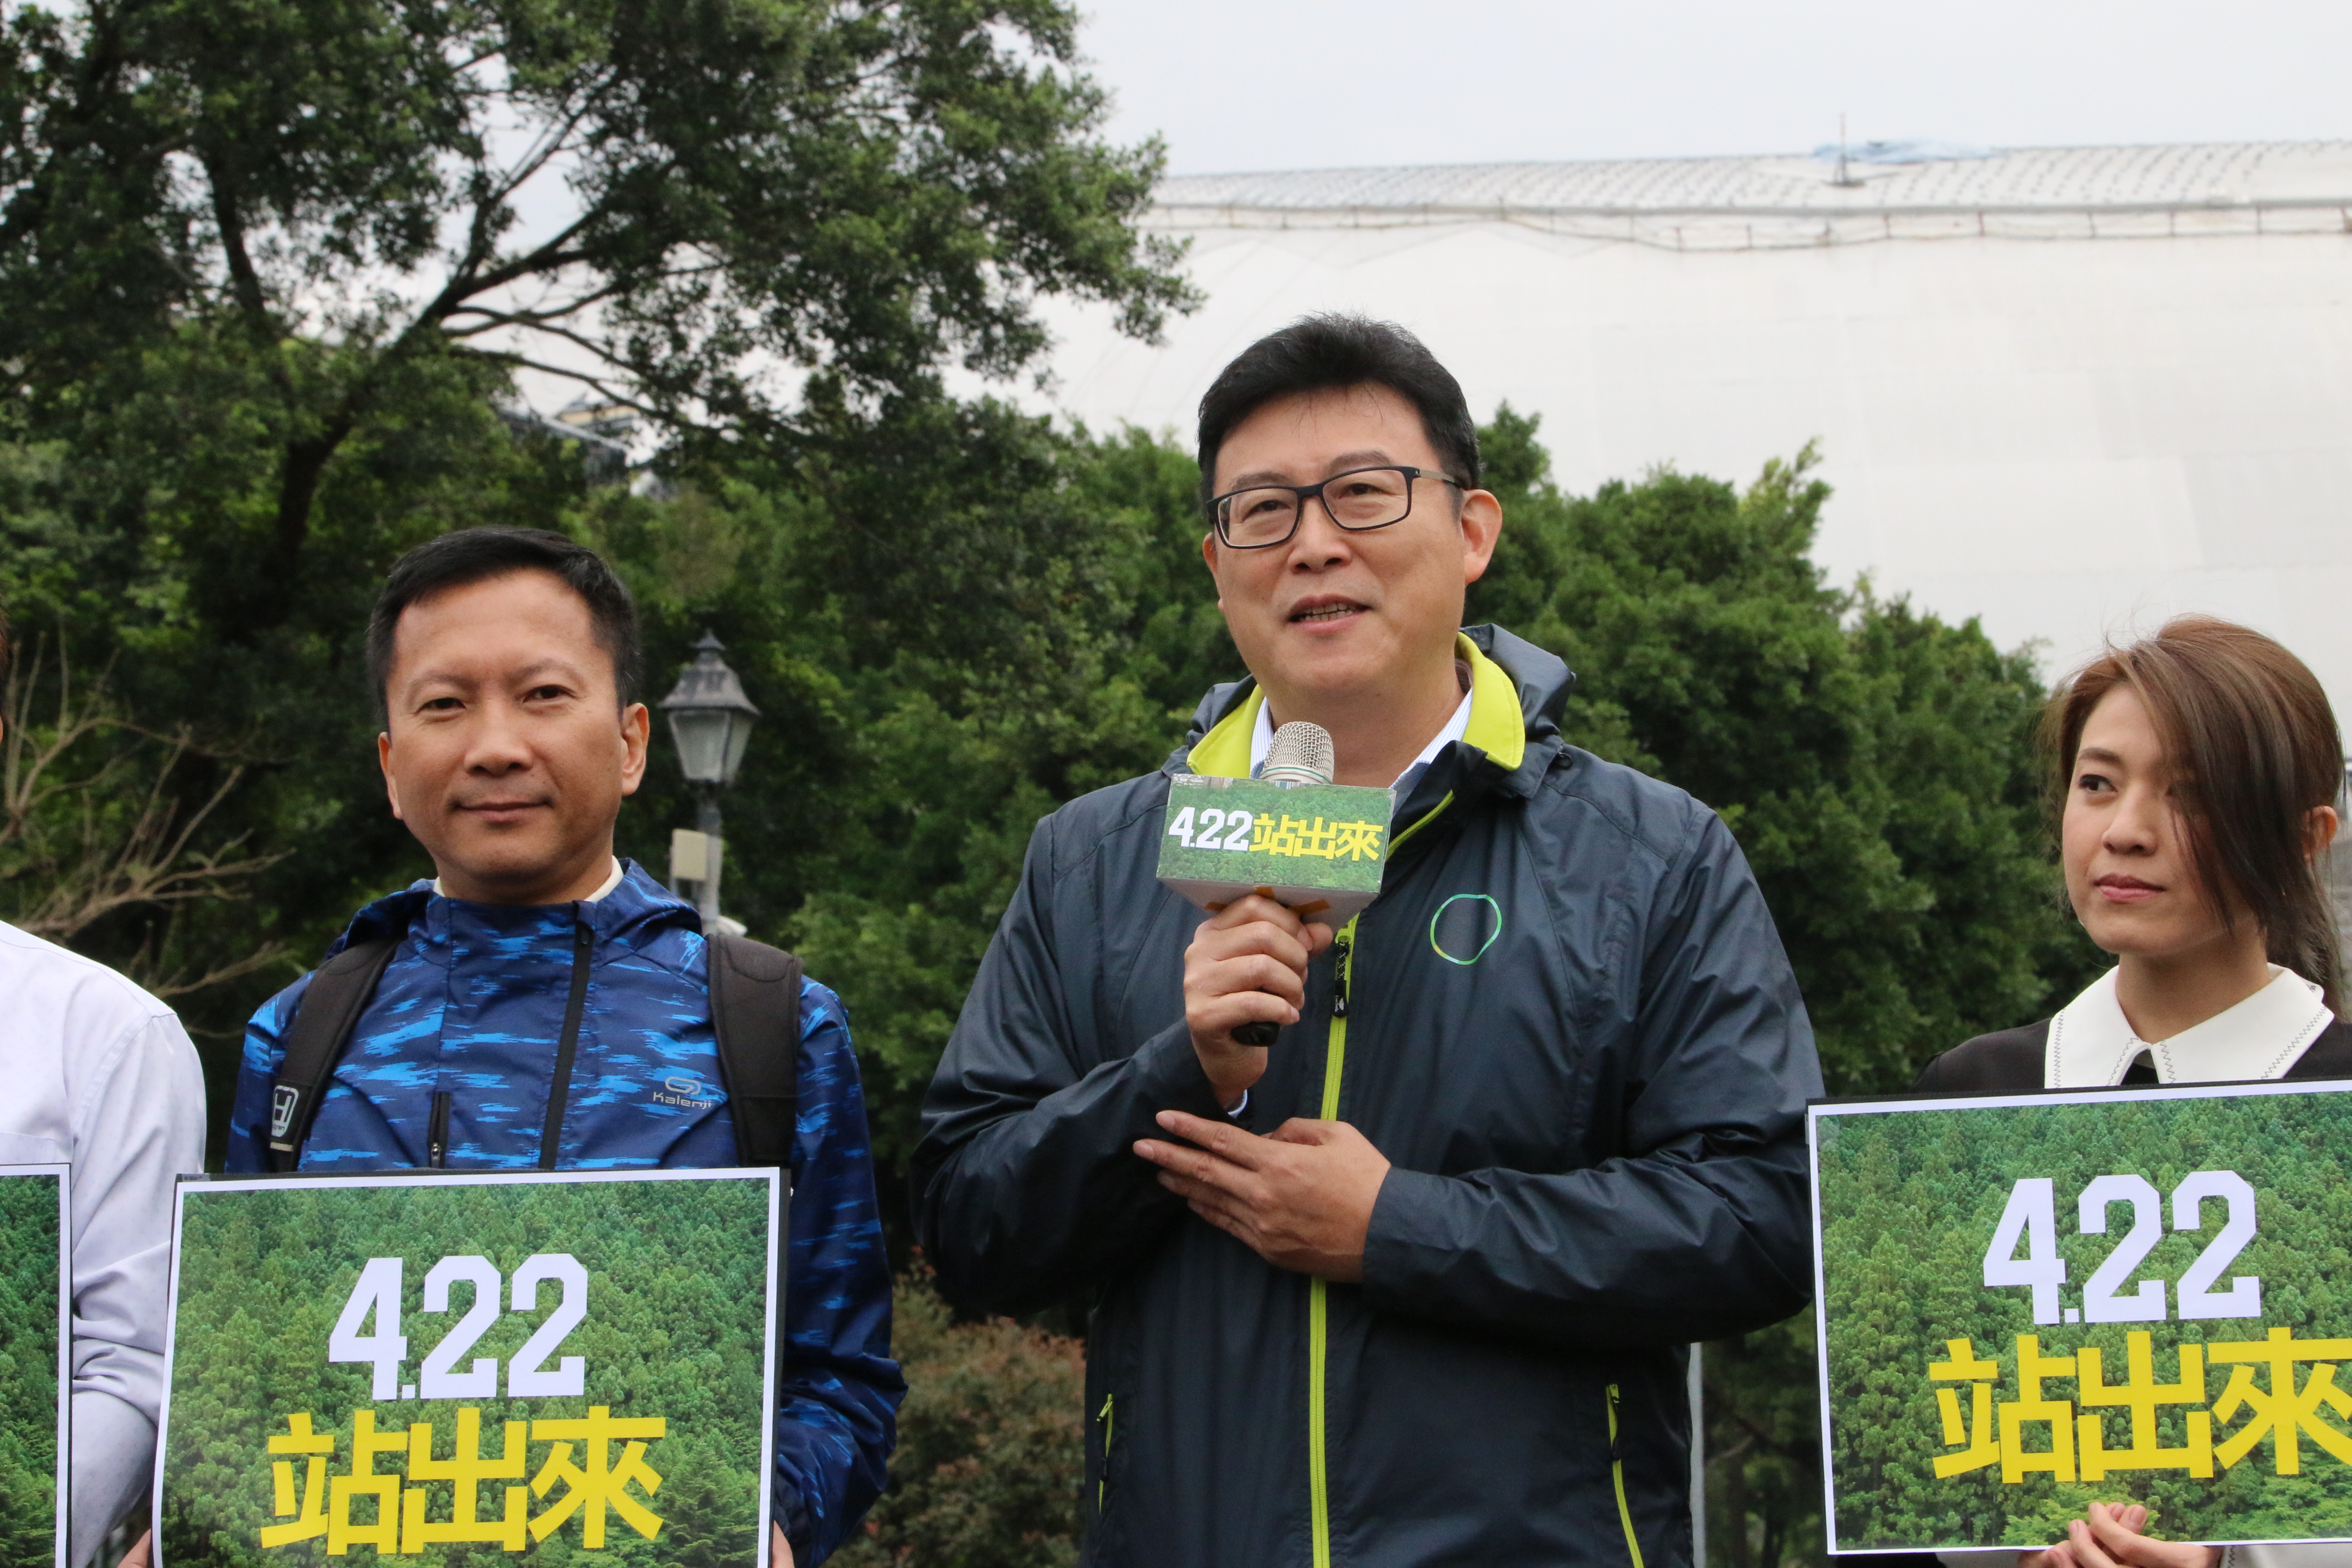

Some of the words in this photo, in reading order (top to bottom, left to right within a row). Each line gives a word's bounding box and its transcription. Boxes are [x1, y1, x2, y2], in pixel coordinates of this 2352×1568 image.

[653, 1092, 711, 1109] Kalenji
[1983, 1170, 2261, 1325] 4.22
[328, 1253, 588, 1400] 4.22
[1929, 1326, 2352, 1484] 站出來
[260, 1406, 666, 1555] 站出來
